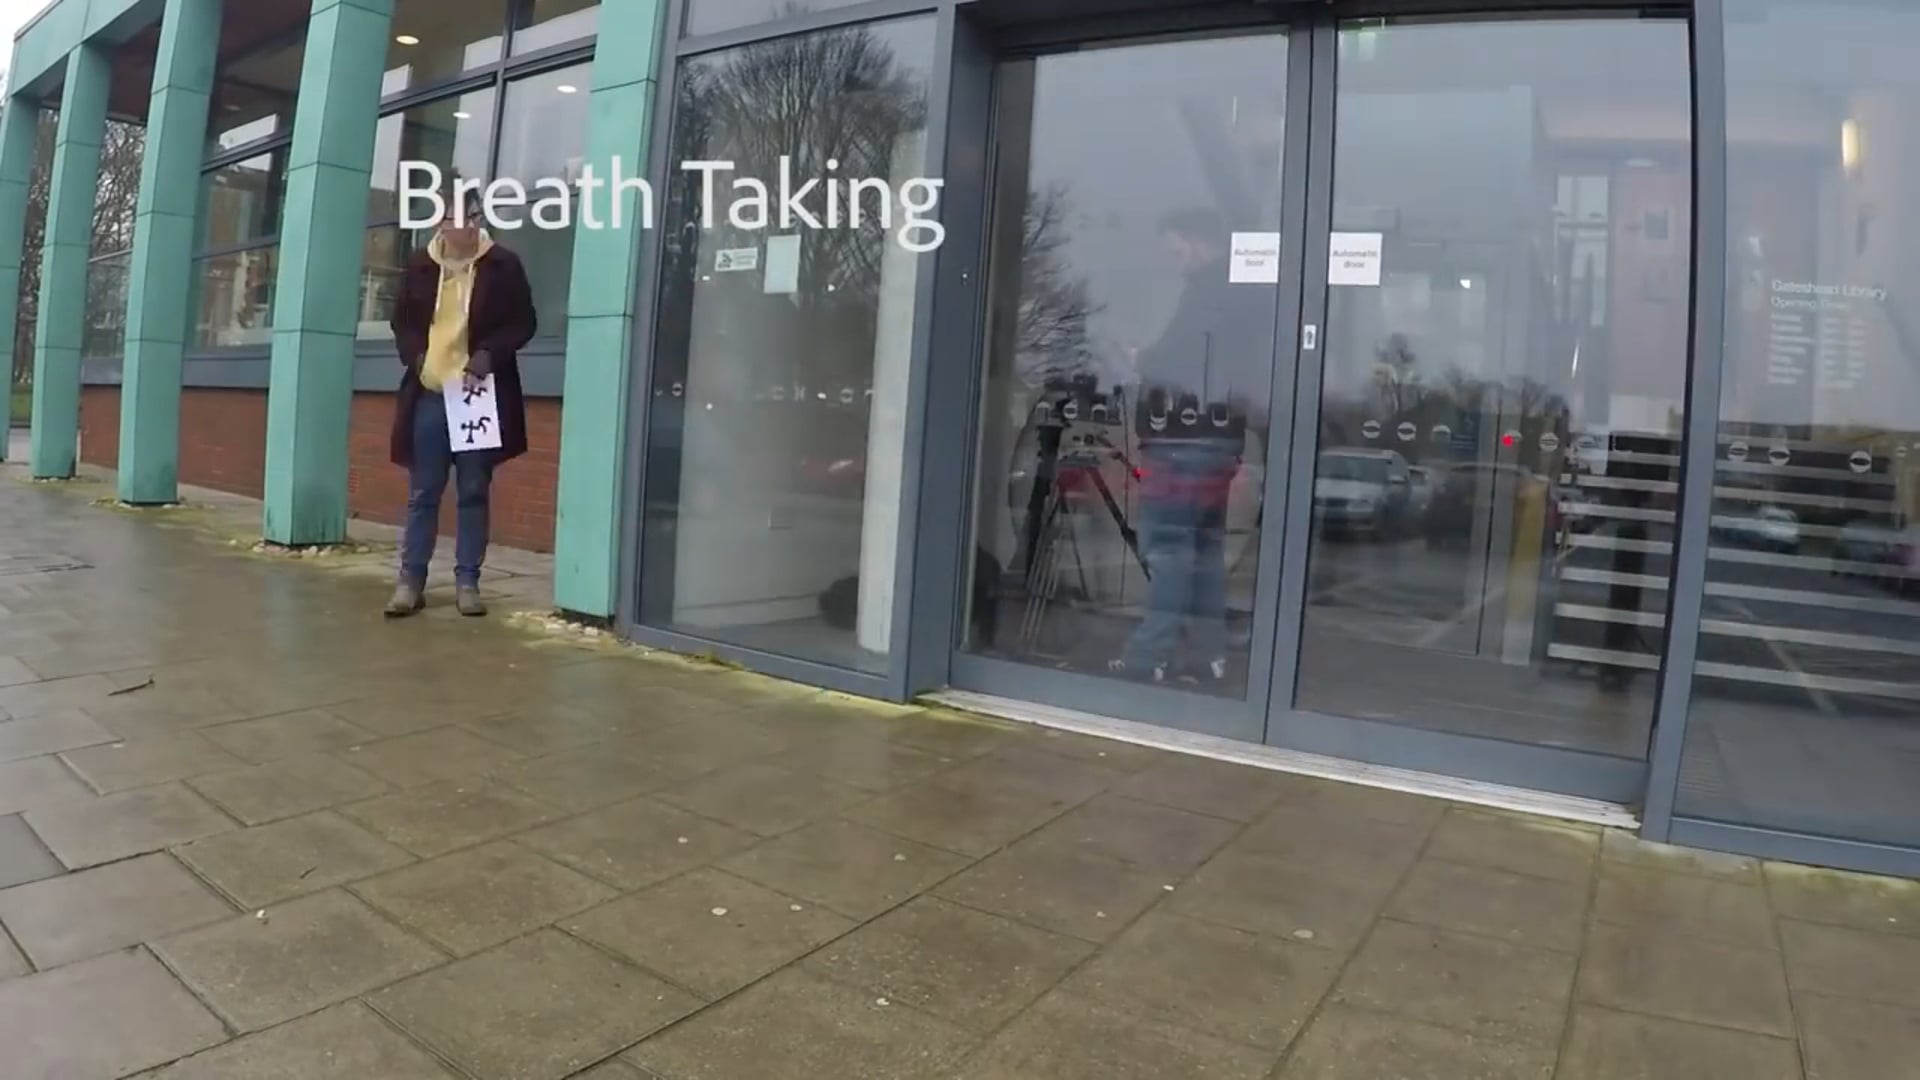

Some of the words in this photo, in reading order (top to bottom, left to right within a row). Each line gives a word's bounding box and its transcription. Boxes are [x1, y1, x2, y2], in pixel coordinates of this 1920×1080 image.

[1333, 249, 1377, 258] Automatic
[1771, 279, 1839, 296] Gateshead
[1842, 284, 1887, 301] Library
